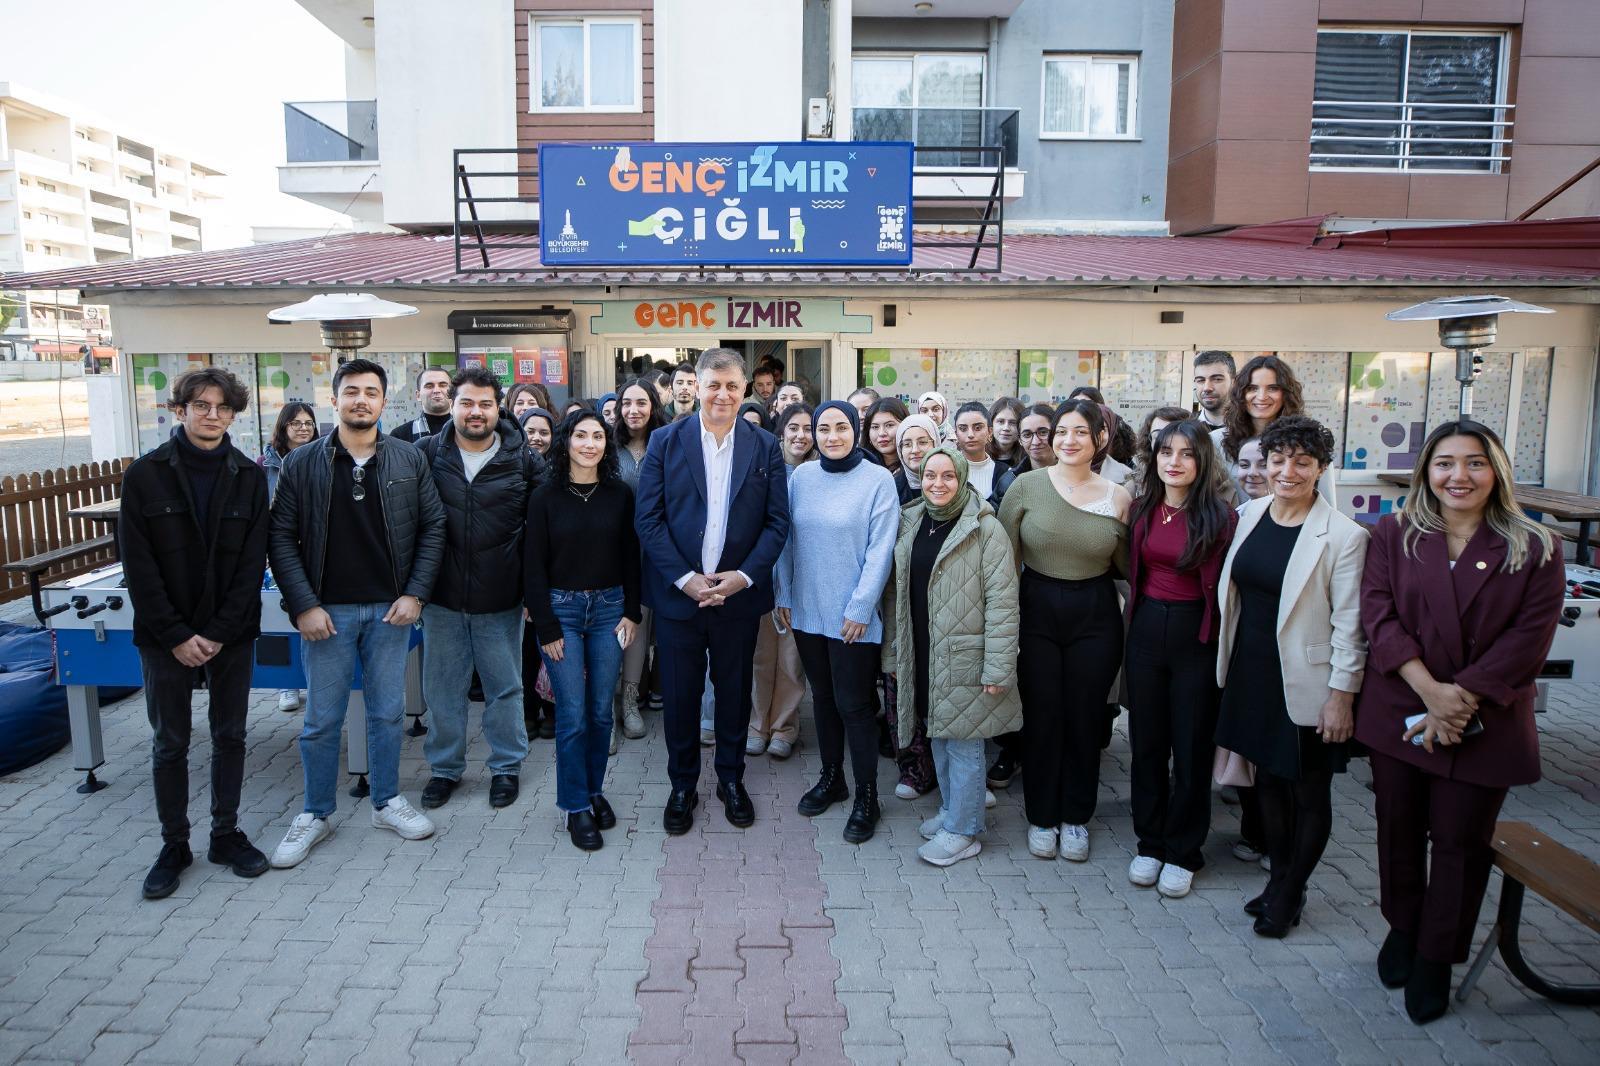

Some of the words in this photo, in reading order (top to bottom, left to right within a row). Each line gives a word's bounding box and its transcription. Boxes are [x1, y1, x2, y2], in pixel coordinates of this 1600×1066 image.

[608, 160, 726, 197] GENÇ
[737, 155, 849, 193] İZMİR
[653, 197, 801, 245] ÇİĞLİ
